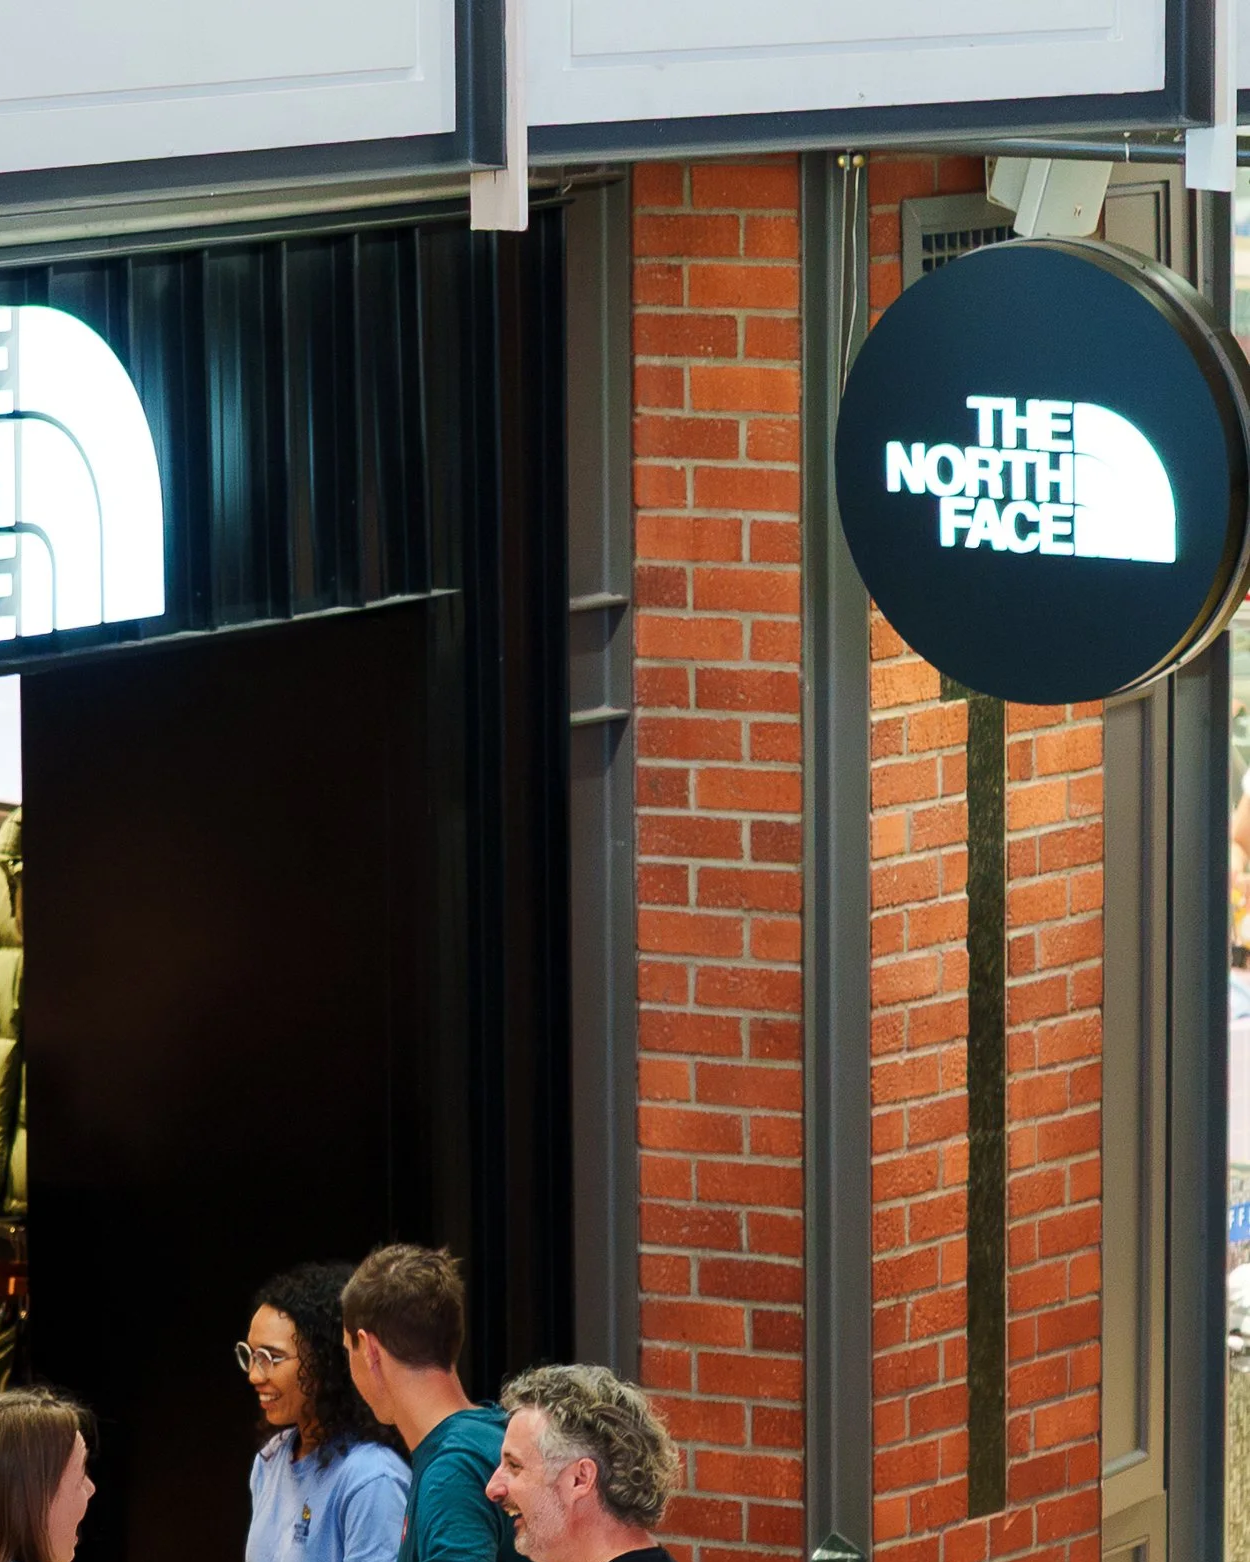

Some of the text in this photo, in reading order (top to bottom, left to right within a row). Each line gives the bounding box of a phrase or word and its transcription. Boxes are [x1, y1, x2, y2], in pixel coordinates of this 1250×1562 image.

[966, 395, 1074, 452] THE
[885, 441, 1074, 504] NORTH
[938, 496, 1074, 556] FACE
